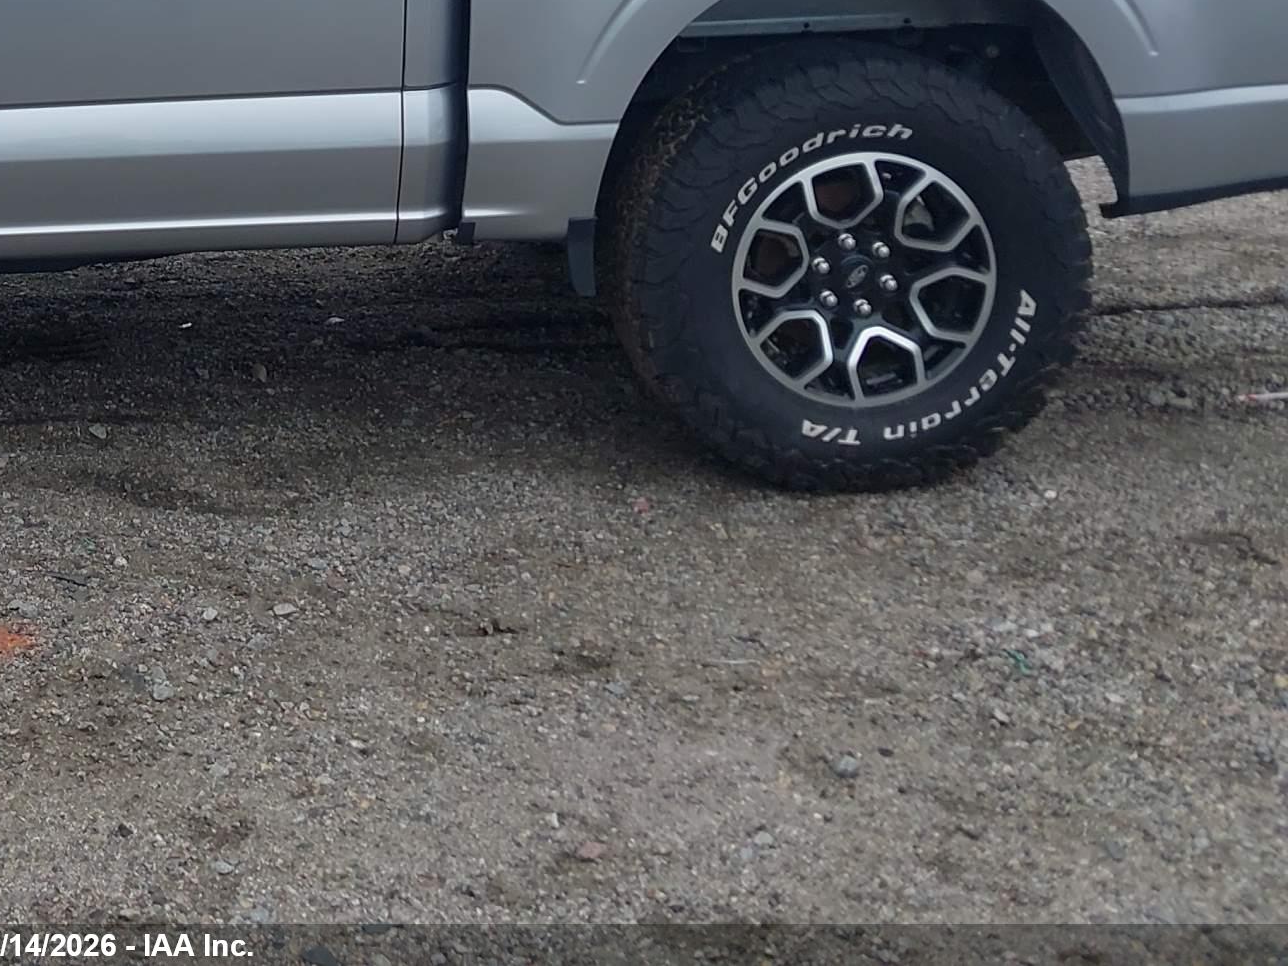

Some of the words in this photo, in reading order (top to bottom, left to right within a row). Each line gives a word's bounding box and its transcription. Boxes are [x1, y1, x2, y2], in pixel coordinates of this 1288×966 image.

[711, 124, 913, 253] BFGoodrich
[883, 289, 1037, 441] All-Terrain
[801, 418, 861, 445] T/A
